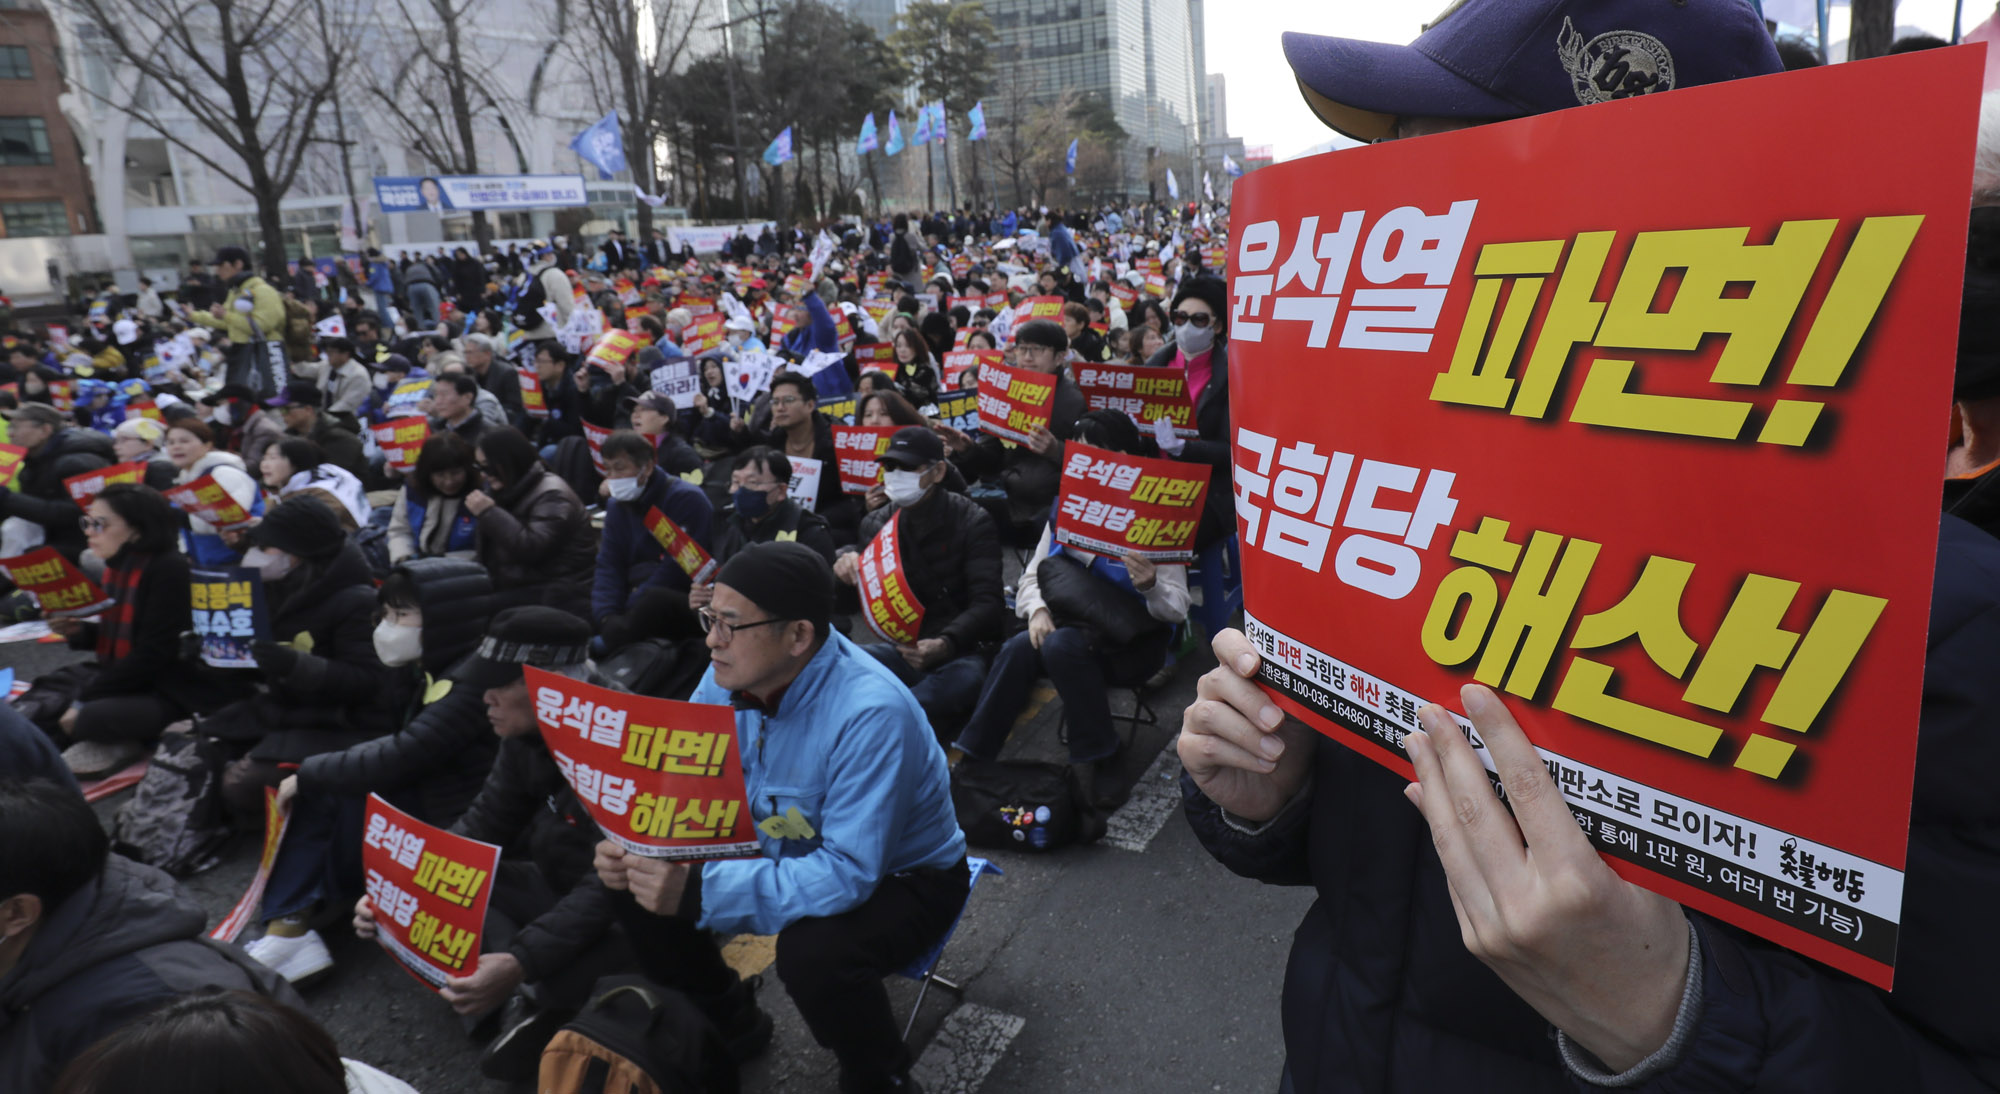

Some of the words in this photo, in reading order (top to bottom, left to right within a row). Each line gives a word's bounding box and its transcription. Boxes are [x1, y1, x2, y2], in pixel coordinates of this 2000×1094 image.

[1230, 199, 1478, 352] 윤석열
[1429, 215, 1925, 447] 파면!
[978, 362, 1012, 391] 윤석열
[1007, 379, 1052, 406] 파면!
[978, 392, 1012, 420] 국힘당
[1079, 369, 1134, 389] 윤석열
[1134, 378, 1183, 397] 파면!
[1090, 395, 1144, 414] 국힘당
[1143, 403, 1190, 425] 해산!
[835, 431, 878, 450] 윤석열
[840, 458, 880, 478] 국힘당
[1064, 453, 1142, 491] 윤석열
[1129, 475, 1205, 507] 파면!
[1061, 493, 1136, 532] 국힘당
[1125, 517, 1196, 547] 해산!
[871, 599, 913, 643] 해산!
[883, 572, 919, 624] 파면!
[1234, 427, 1459, 600] 국힘당
[1421, 516, 1889, 780] 해산!
[536, 686, 627, 748] 윤석열
[621, 723, 731, 776] 파면!
[1277, 640, 1302, 670] 파면
[1306, 653, 1346, 691] 국힘당
[1350, 674, 1381, 708] 해산
[1650, 799, 1758, 859] 모이자!
[553, 749, 636, 816] 국힘당
[629, 792, 740, 839] 해산!
[1292, 679, 1371, 729] 100-036-164860
[1372, 718, 1407, 750] 촛불행
[1599, 821, 1638, 853] 통에
[1645, 839, 1678, 869] 1만
[1685, 852, 1712, 883] 원,
[1719, 867, 1764, 901] 여러
[1773, 886, 1795, 914] 번
[1803, 899, 1864, 942] 가능)
[364, 812, 426, 870] 윤석열
[412, 850, 487, 908] 파면!
[1779, 838, 1866, 903] 촛불행동
[366, 868, 419, 928] 국힘당
[409, 910, 476, 969] 해산!
